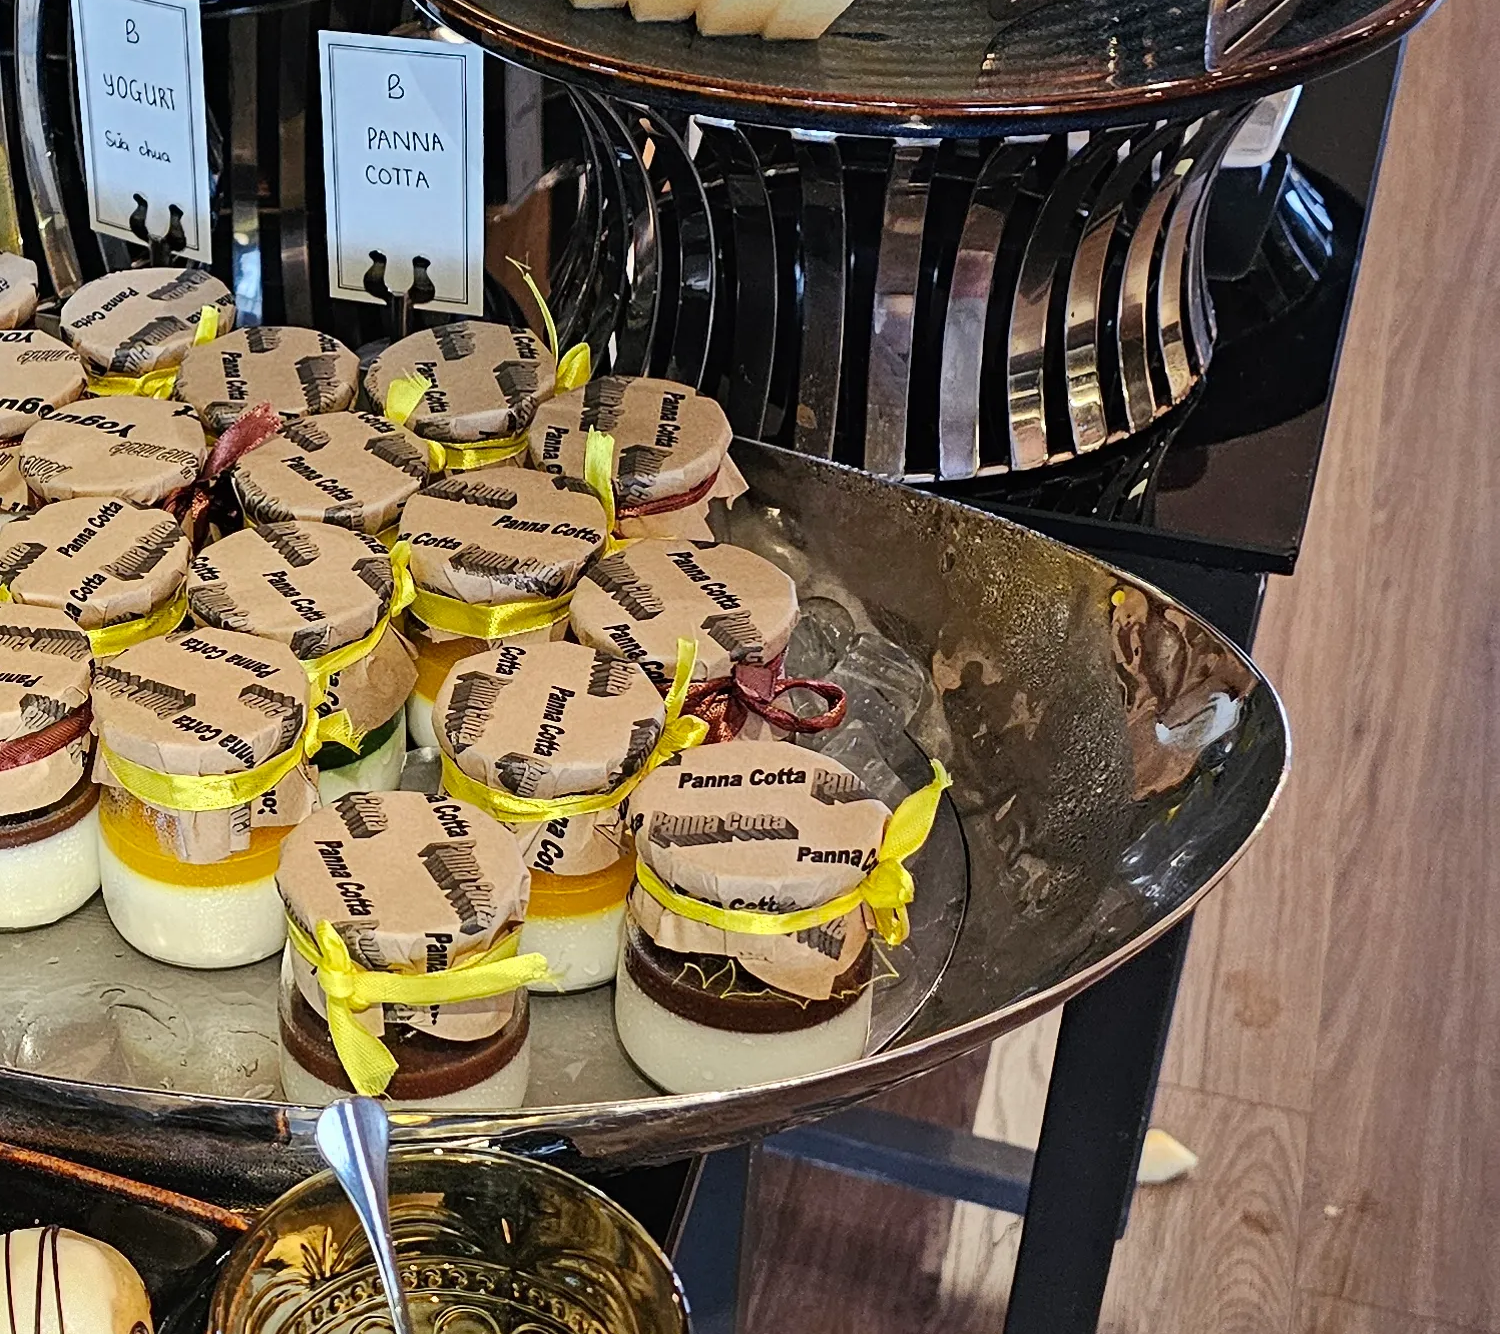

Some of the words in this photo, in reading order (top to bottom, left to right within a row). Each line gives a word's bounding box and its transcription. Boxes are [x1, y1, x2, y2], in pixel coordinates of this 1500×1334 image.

[125, 18, 141, 45] B
[102, 72, 176, 111] YOGURT
[387, 73, 406, 100] B
[138, 139, 172, 163] chua
[366, 125, 445, 154] PANNA
[364, 164, 431, 190] COTTA
[100, 286, 140, 314] Panna
[70, 309, 107, 330] Cotta
[424, 390, 451, 415] Cotta
[660, 390, 687, 423] Panna
[48, 410, 137, 439] Yogur
[655, 423, 682, 449] Cotta
[542, 425, 570, 462] Panna
[280, 455, 324, 482] Panna
[314, 478, 356, 503] Cotta
[56, 526, 99, 558] Panna
[87, 500, 124, 529] Cotta
[412, 531, 463, 551] Cotta
[491, 514, 550, 535] Panna
[550, 522, 602, 545] Cotta
[190, 556, 221, 582] Cotta
[450, 542, 519, 576] Panna
[69, 571, 108, 603] Cotta
[262, 570, 302, 599] Panna
[666, 551, 711, 583] Panna
[700, 582, 743, 611] Cotta
[180, 637, 228, 660] Cotta
[602, 623, 649, 662] Panna
[225, 653, 281, 679] Panna
[495, 646, 527, 675] Cotta
[542, 685, 576, 722] Panna
[171, 715, 223, 742] Cotta
[533, 723, 566, 757] Cotta
[678, 771, 743, 790] Panna
[748, 767, 807, 786] Cotta
[432, 803, 473, 838] Cotta
[650, 810, 721, 846] Panna
[719, 811, 796, 843] Cotta
[796, 846, 863, 868] Panna
[313, 840, 352, 881] Panna
[335, 881, 375, 916] Cotta
